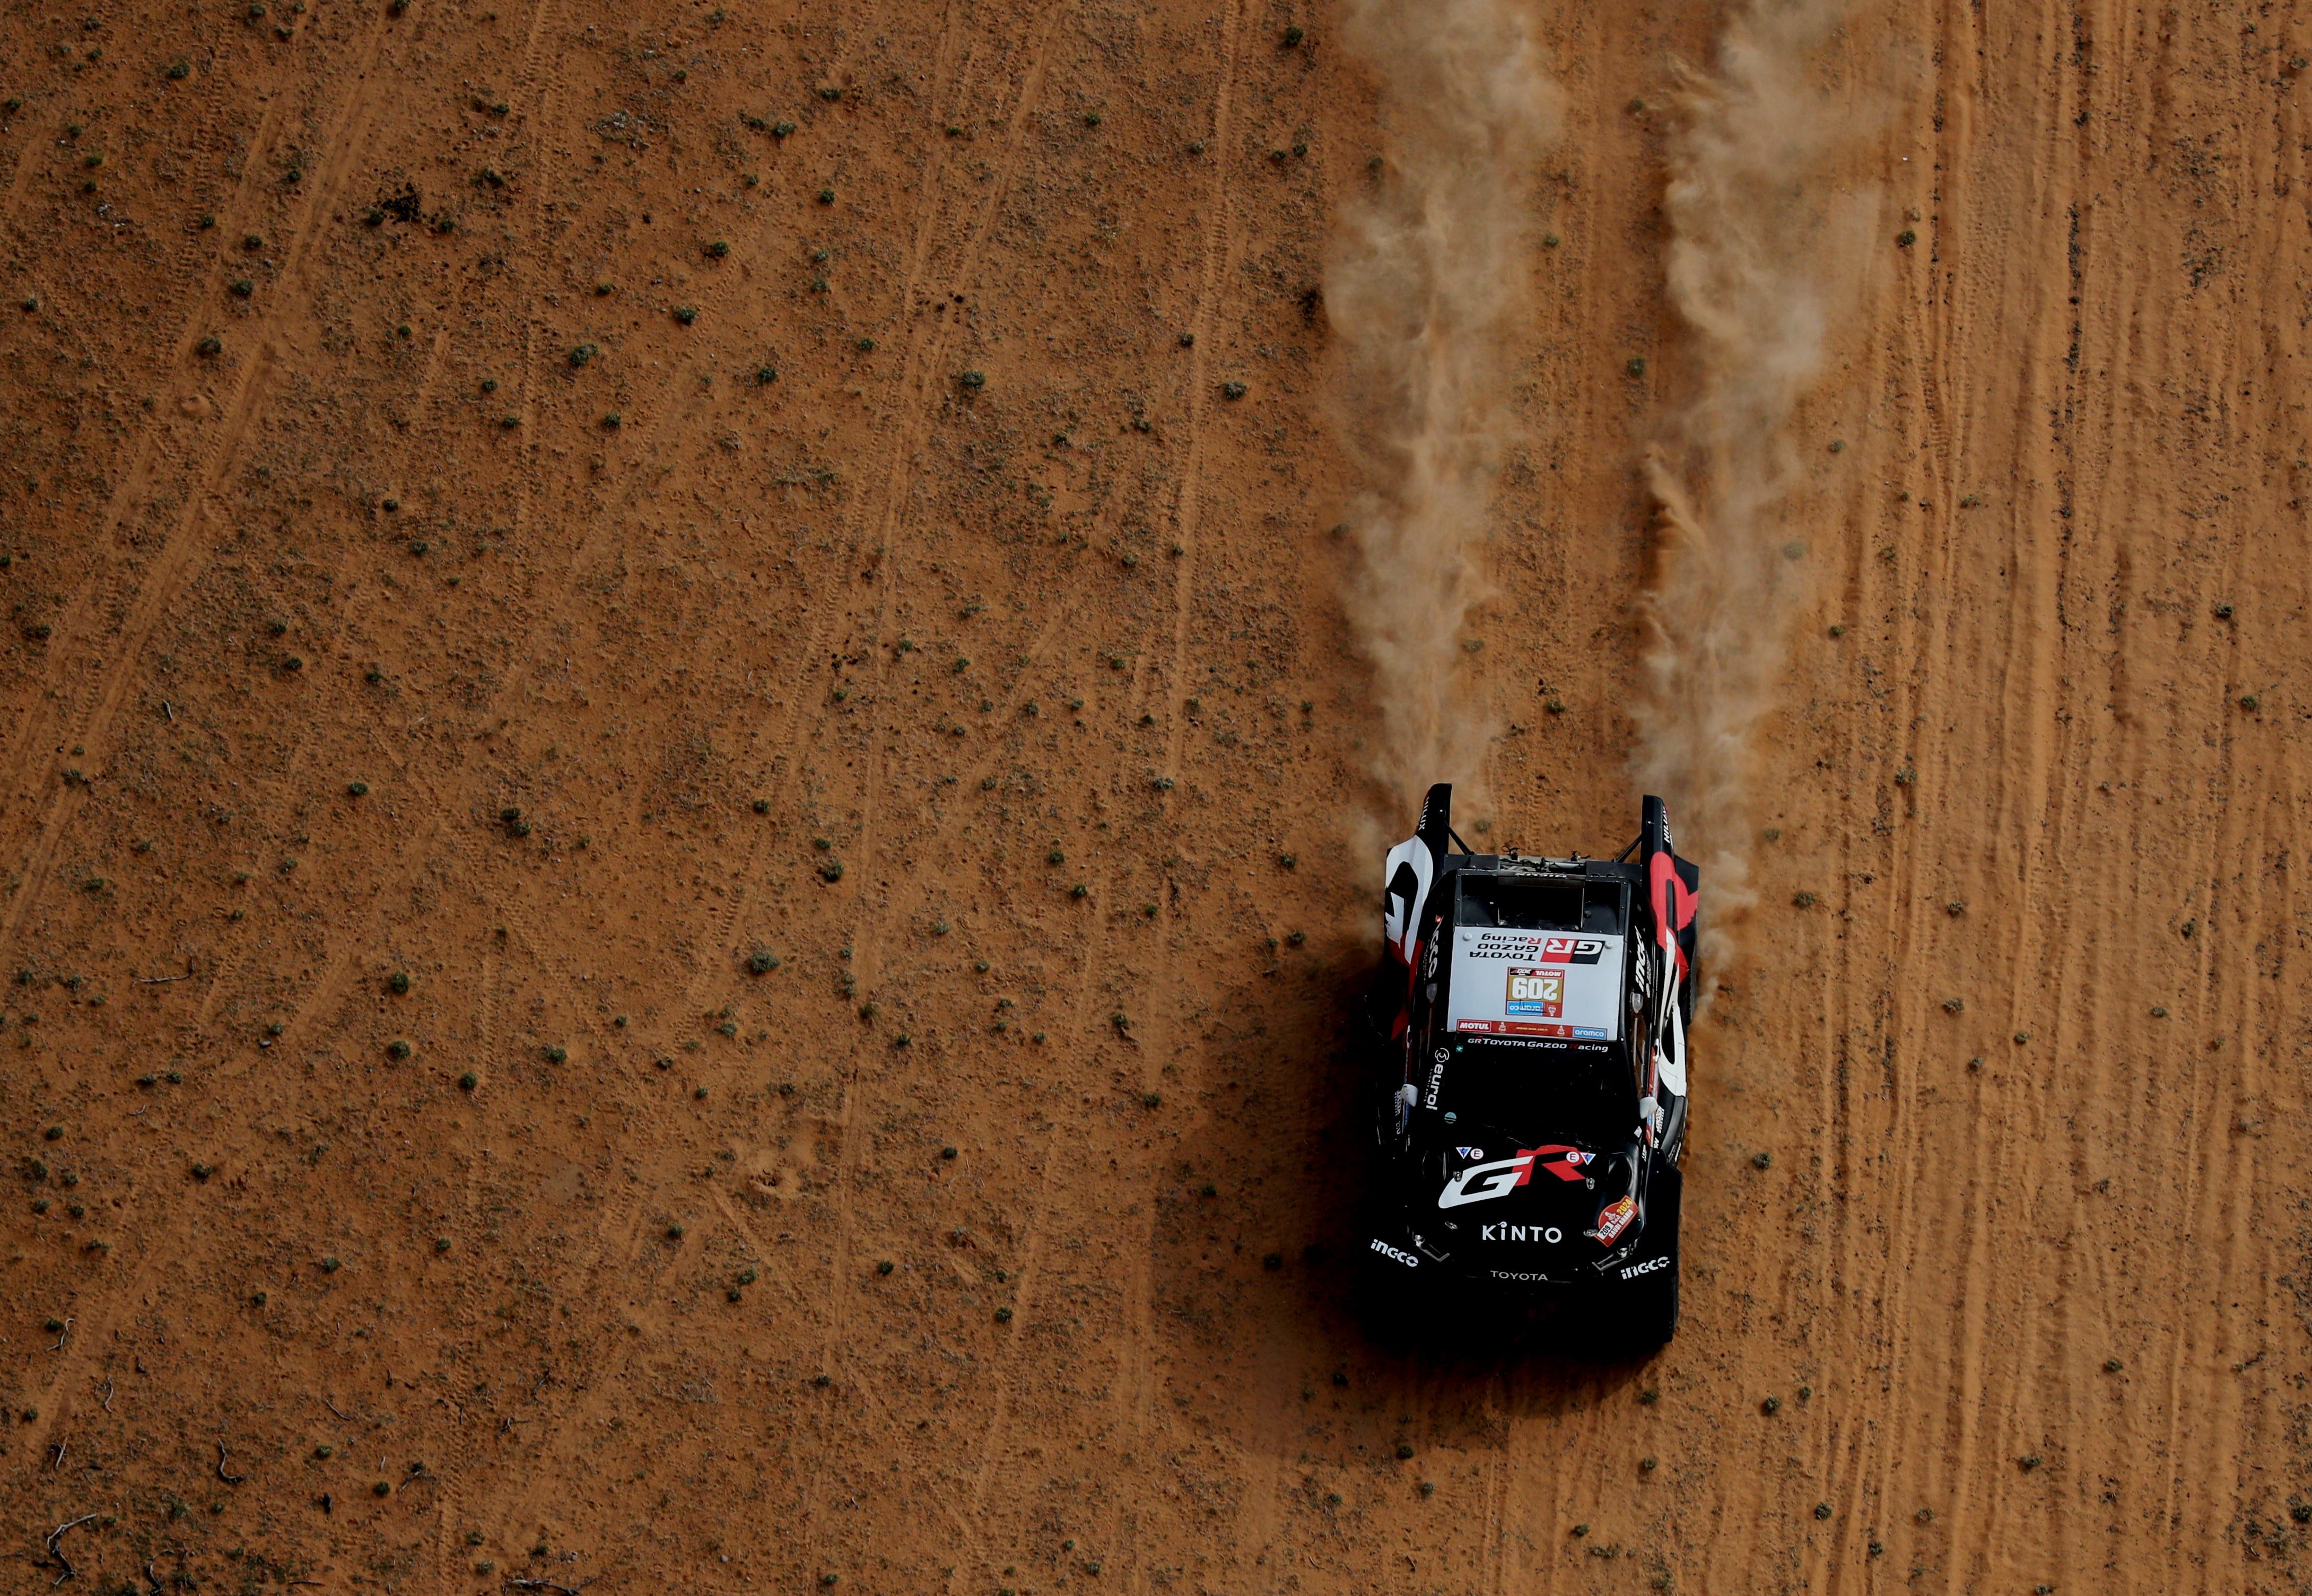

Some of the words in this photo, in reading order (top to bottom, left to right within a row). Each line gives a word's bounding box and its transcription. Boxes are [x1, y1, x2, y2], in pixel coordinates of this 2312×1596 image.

[1481, 933, 1542, 945] Racing
[1477, 943, 1539, 953] GAZOO
[1546, 939, 1603, 955] GR
[1469, 951, 1536, 961] TOYOTA
[1512, 977, 1558, 1001] 209
[1482, 1038, 1525, 1048] TOYOTA
[1528, 1041, 1567, 1049] GAZOO
[1570, 1043, 1609, 1053] Racing
[1426, 1063, 1444, 1110] eurol
[1438, 1144, 1586, 1209] GR
[1616, 1198, 1634, 1216] 2024
[1600, 1225, 1611, 1236] 209
[1608, 1223, 1622, 1239] SAUDI
[1619, 1209, 1634, 1226] ARABIA
[1490, 1270, 1548, 1281] TOYOTA
